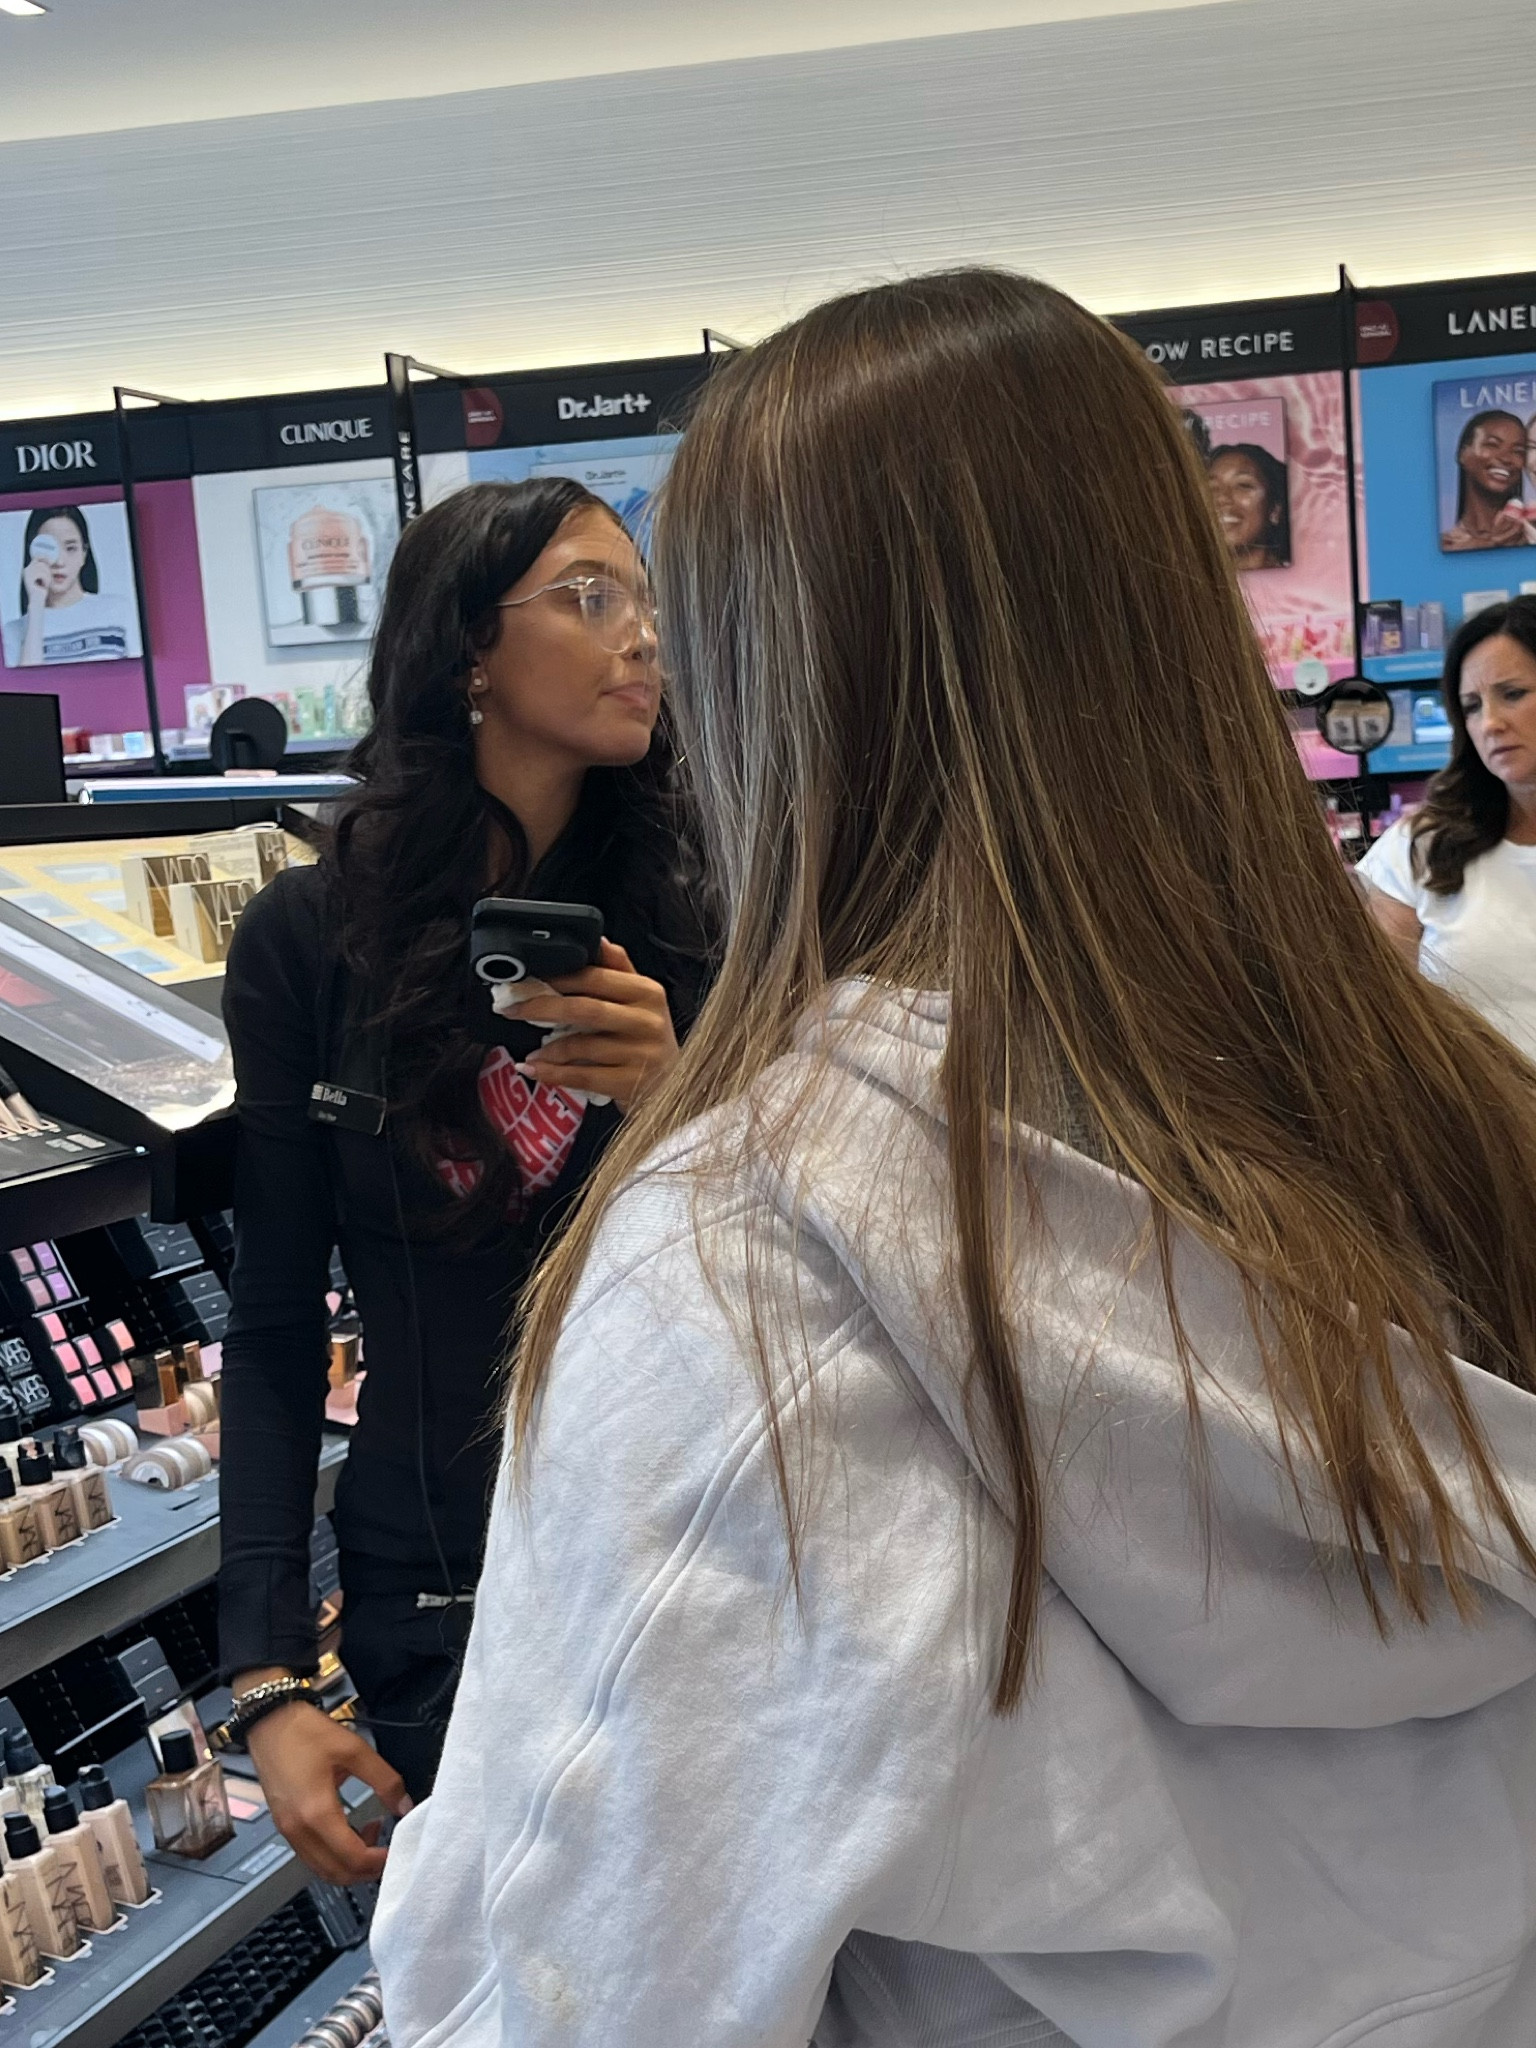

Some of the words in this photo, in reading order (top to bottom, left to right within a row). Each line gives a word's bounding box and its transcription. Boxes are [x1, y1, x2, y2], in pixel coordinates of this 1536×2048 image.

[1201, 331, 1294, 359] RECIPE
[558, 393, 651, 419] Dr.Jart+
[281, 418, 373, 445] CLINIQUE
[1203, 411, 1271, 430] RECIPE
[15, 440, 98, 473] DIOR
